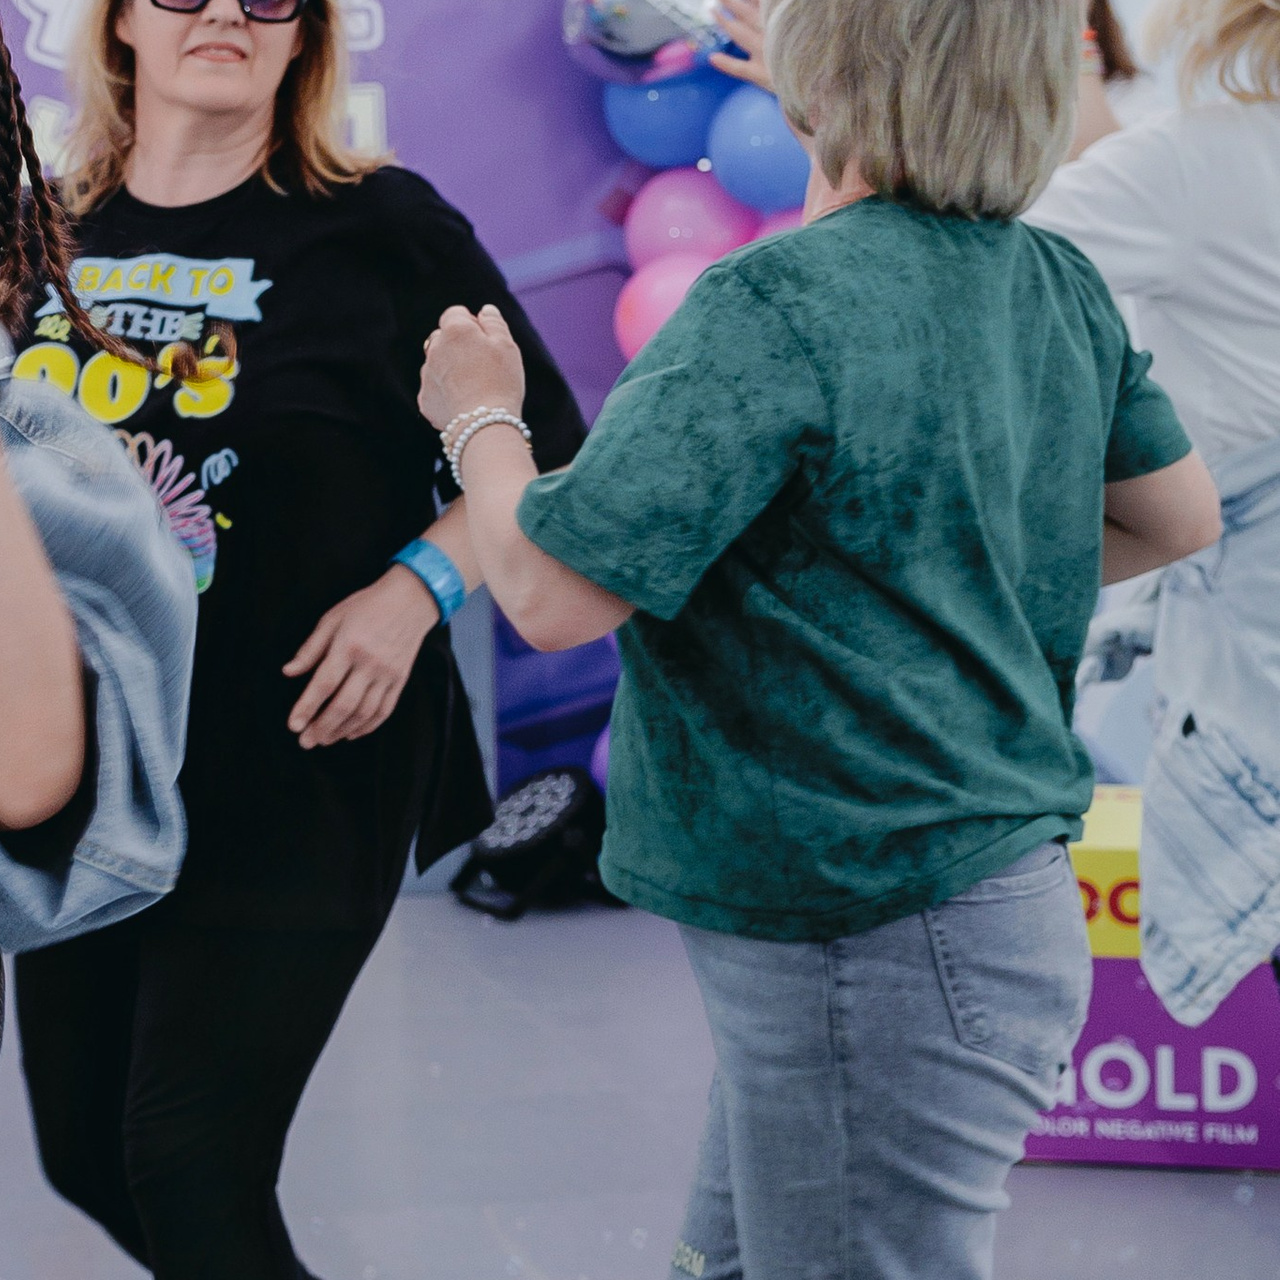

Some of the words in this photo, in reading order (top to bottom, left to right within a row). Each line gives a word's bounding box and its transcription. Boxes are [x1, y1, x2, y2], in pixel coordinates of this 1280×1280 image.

[76, 263, 176, 295] BACK
[189, 266, 234, 297] TO
[104, 303, 185, 342] THE
